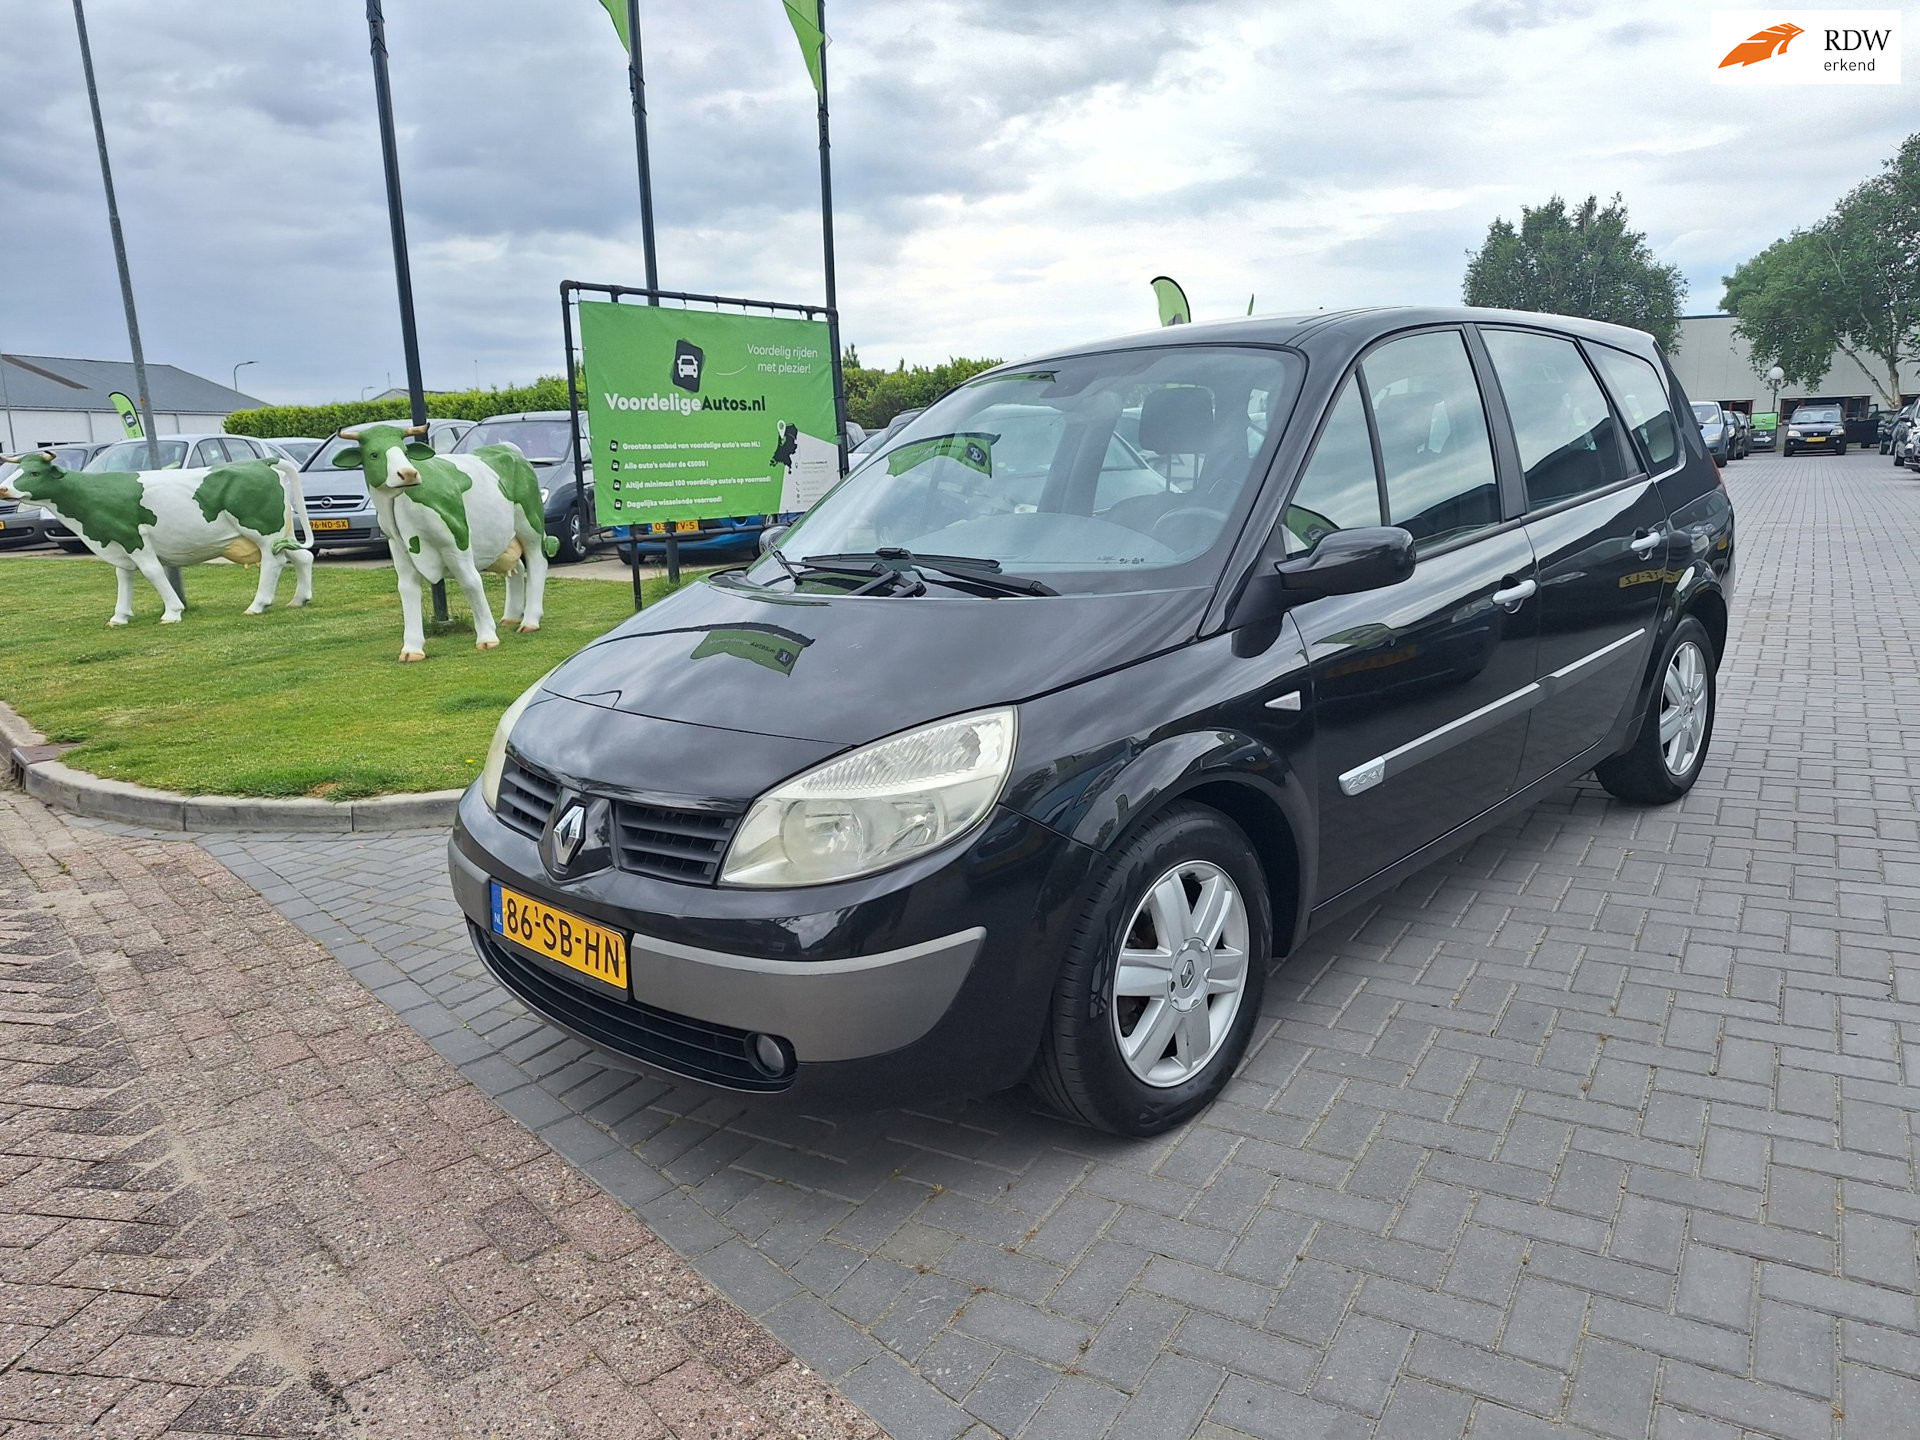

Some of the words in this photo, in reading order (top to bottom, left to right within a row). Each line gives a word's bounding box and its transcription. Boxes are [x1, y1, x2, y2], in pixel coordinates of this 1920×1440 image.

[747, 343, 791, 360] Voordelig
[792, 346, 818, 361] rijden
[757, 363, 777, 372] met
[778, 361, 811, 375] plezier!
[604, 393, 766, 416] VoordeligeAutos.nl
[622, 442, 652, 450] Grootste
[690, 441, 721, 450] voordelige
[624, 462, 637, 470] Alle
[638, 461, 658, 469] auto's
[625, 480, 644, 489] Altijd
[644, 480, 674, 488] minimaal
[686, 478, 718, 486] voordelige
[718, 477, 736, 485] auto's
[626, 500, 657, 509] Dagelijks
[658, 498, 693, 506] wisselende
[494, 912, 503, 926] NL
[507, 897, 619, 978] 86-SB-HN
